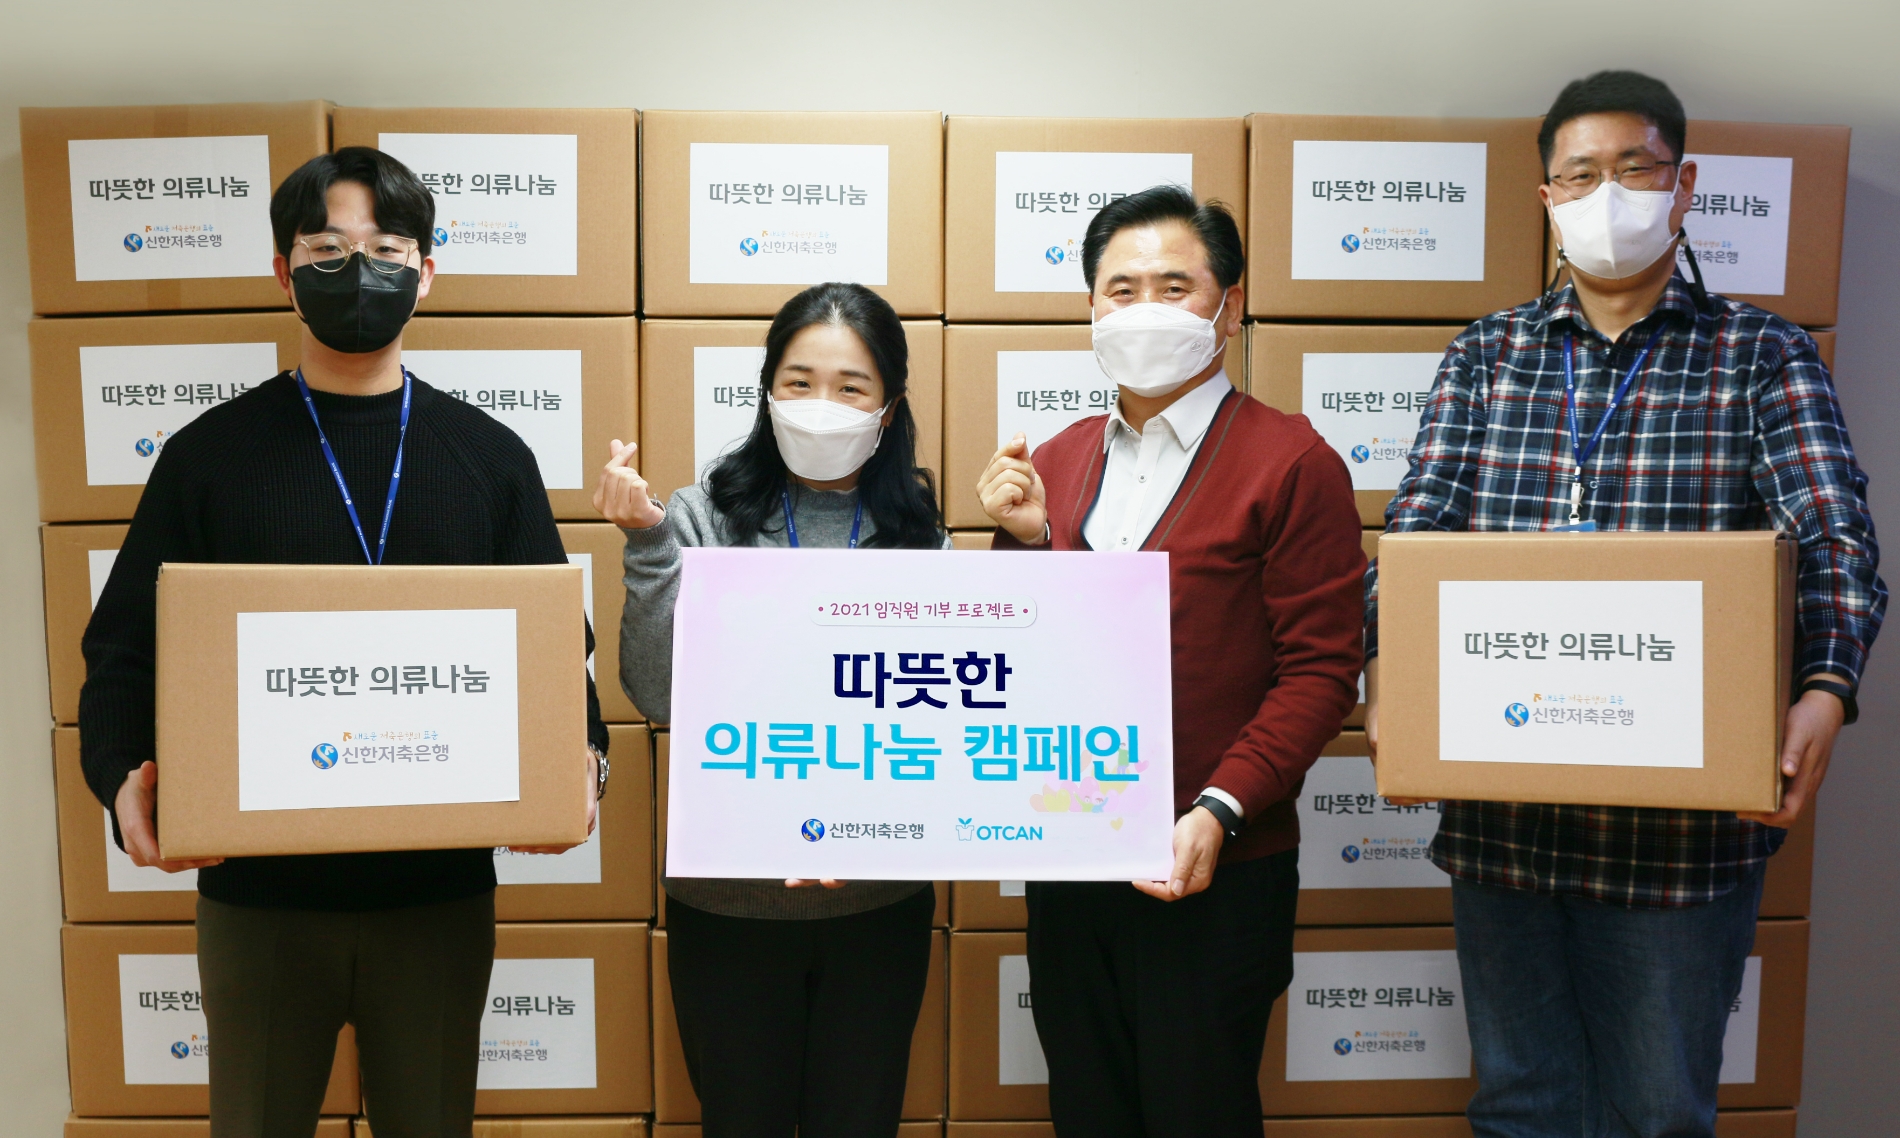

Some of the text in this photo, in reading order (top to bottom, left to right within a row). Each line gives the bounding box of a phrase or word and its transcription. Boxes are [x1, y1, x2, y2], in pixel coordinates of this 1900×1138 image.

[89, 176, 250, 201] 따뜻한 의류나눔
[416, 173, 557, 196] 뜻한 의류나눔
[709, 183, 868, 206] 따뜻한 의류나눔
[1312, 180, 1467, 203] 따뜻한 의류나눔
[1015, 192, 1080, 213] 따뜻한
[1690, 194, 1771, 217] 의류나눔
[145, 234, 222, 249] 신한저축은행
[450, 231, 527, 245] 신한저축은행
[761, 240, 837, 255] 신한저축은행
[1362, 237, 1436, 252] 신한저축은행
[1677, 250, 1739, 264] 한저축은행
[102, 384, 166, 406] 따뜻한
[476, 390, 562, 411] 의류나눔
[714, 386, 762, 408] 따뜻
[1017, 390, 1082, 411] 따뜻한
[1322, 392, 1386, 413] 따뜻한
[830, 602, 1016, 620] 2021 임직원 기부 프로젝트
[1464, 632, 1676, 662] 따뜻한 의류나눔
[266, 664, 490, 698] 따뜻한 의류나눔
[832, 651, 1012, 710] 따뜻한
[1532, 708, 1634, 726] 신한저축은행
[342, 744, 450, 764] 신한저축은행
[700, 722, 1140, 782] 의류나눔 캠페인
[1314, 794, 1376, 814] 따뜻한
[829, 822, 925, 840] 신한저축은행
[976, 825, 1043, 841] OTCAN
[138, 990, 202, 1012] 따뜻한
[491, 996, 576, 1016] 의류나눔
[1306, 986, 1456, 1008] 따뜻한 의류나눔
[1354, 1039, 1426, 1053] 신한저축은행
